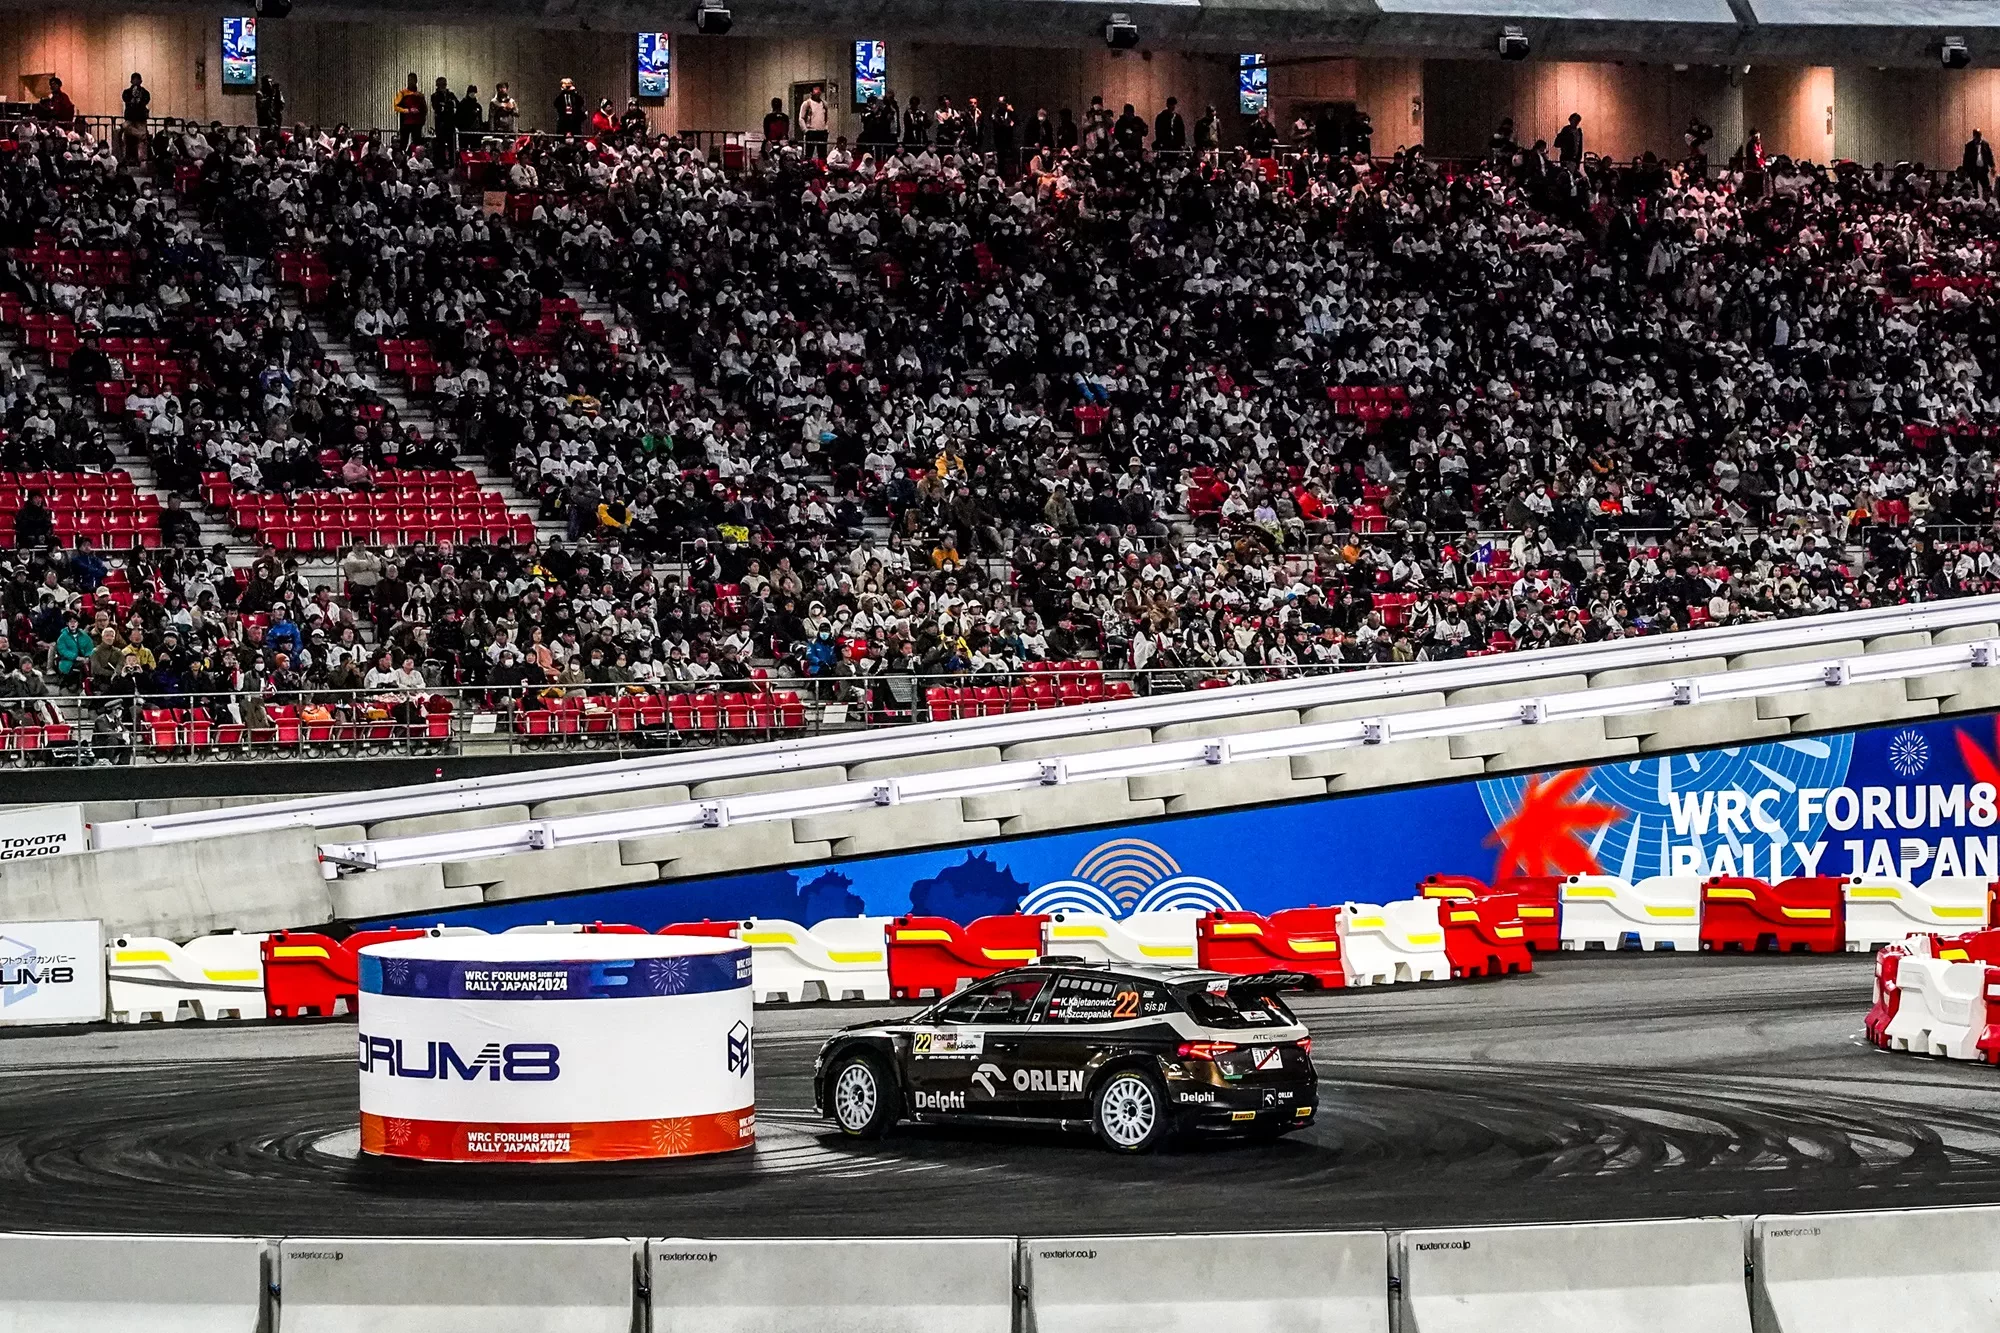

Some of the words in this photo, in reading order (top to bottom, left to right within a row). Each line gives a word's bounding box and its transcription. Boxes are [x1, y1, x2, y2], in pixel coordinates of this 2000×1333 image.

[1667, 788, 1781, 836] WRC
[1798, 782, 1999, 832] FORUM8
[1, 833, 67, 849] TOYOTA
[0, 845, 60, 860] GAZOO
[1671, 840, 1829, 886] RALLY
[1841, 835, 1999, 884] JAPAN
[0, 955, 76, 966] フトウェアカンパニー
[465, 970, 489, 981] WRC
[491, 971, 537, 981] FORUM8
[465, 981, 499, 991] RALLY
[500, 981, 537, 991] JAPAN
[537, 978, 568, 991] 2024
[1113, 991, 1139, 1018] 22
[1144, 1001, 1168, 1012] sjs.pl
[914, 1033, 932, 1053] 22
[1013, 1068, 1085, 1093] ORLEN
[914, 1090, 965, 1112] Delphi
[1180, 1091, 1215, 1104] Delphi
[1277, 1091, 1294, 1099] ORLEN
[467, 1132, 491, 1142] WRC
[494, 1133, 540, 1142] FORUM8
[468, 1142, 502, 1152] RALLY
[504, 1143, 540, 1153] JAPAN
[540, 1140, 571, 1153] 2024
